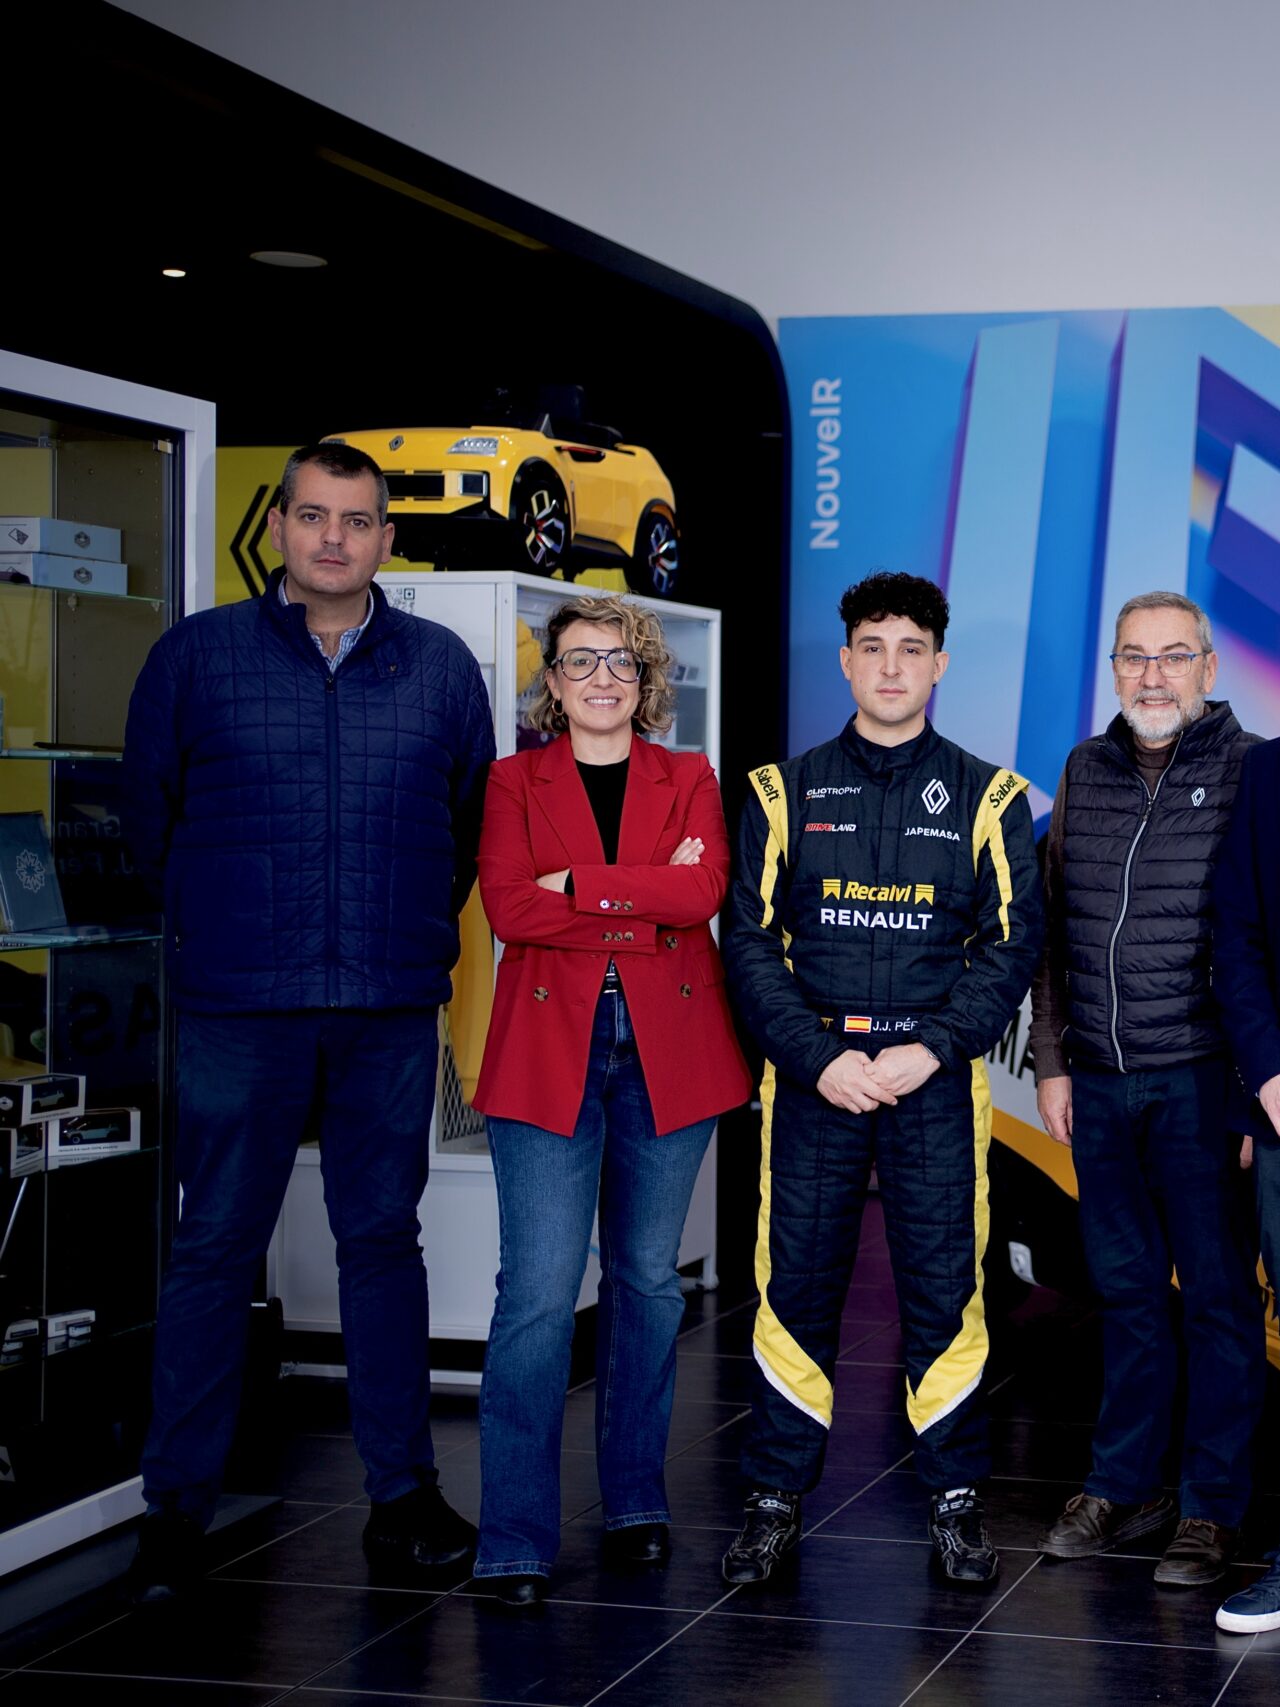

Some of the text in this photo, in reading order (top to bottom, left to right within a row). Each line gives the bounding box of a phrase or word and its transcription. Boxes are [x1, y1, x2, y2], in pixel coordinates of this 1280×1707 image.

[809, 378, 842, 549] NouvelR
[756, 768, 780, 803] Sabelt
[904, 826, 961, 841] JAPEMASA
[843, 881, 912, 902] Recalvi
[820, 908, 933, 930] RENAULT
[872, 1021, 892, 1032] J.J.
